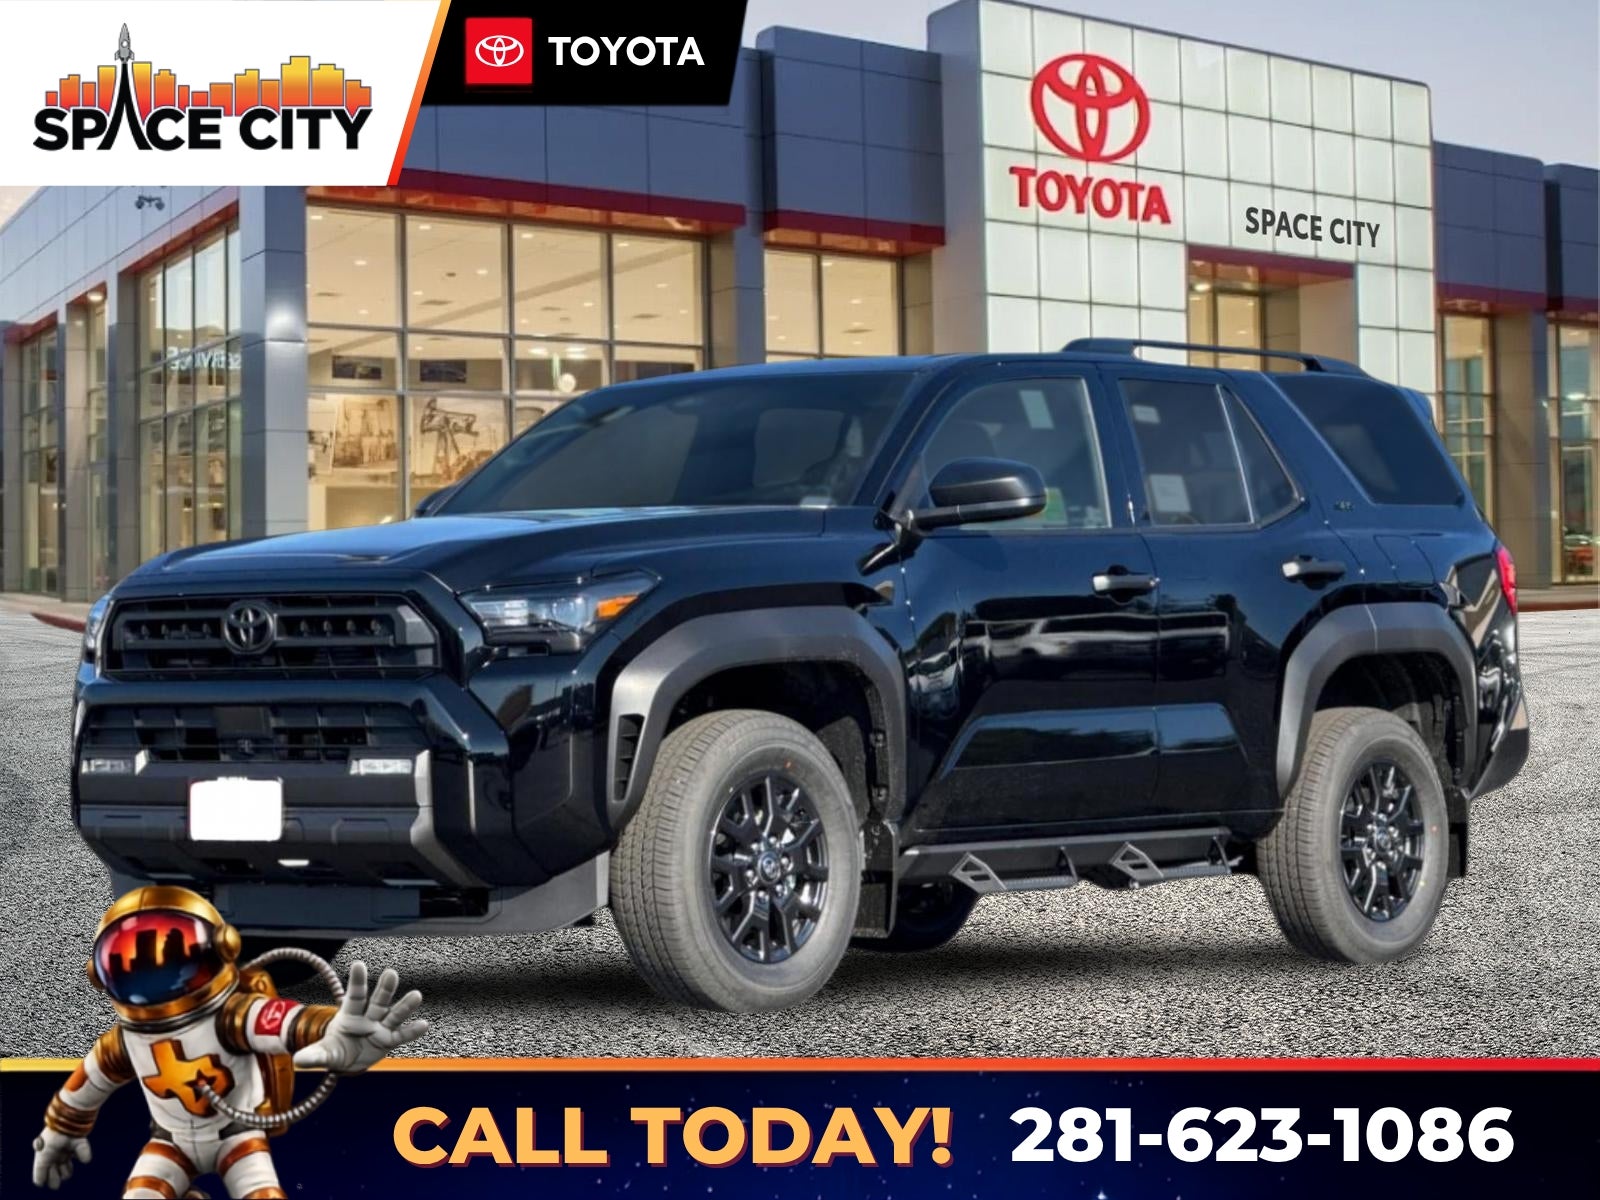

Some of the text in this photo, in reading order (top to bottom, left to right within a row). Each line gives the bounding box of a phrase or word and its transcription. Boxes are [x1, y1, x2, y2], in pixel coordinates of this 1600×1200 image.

[1009, 166, 1171, 224] TOYOTA
[1245, 206, 1380, 248] SPACE CITY
